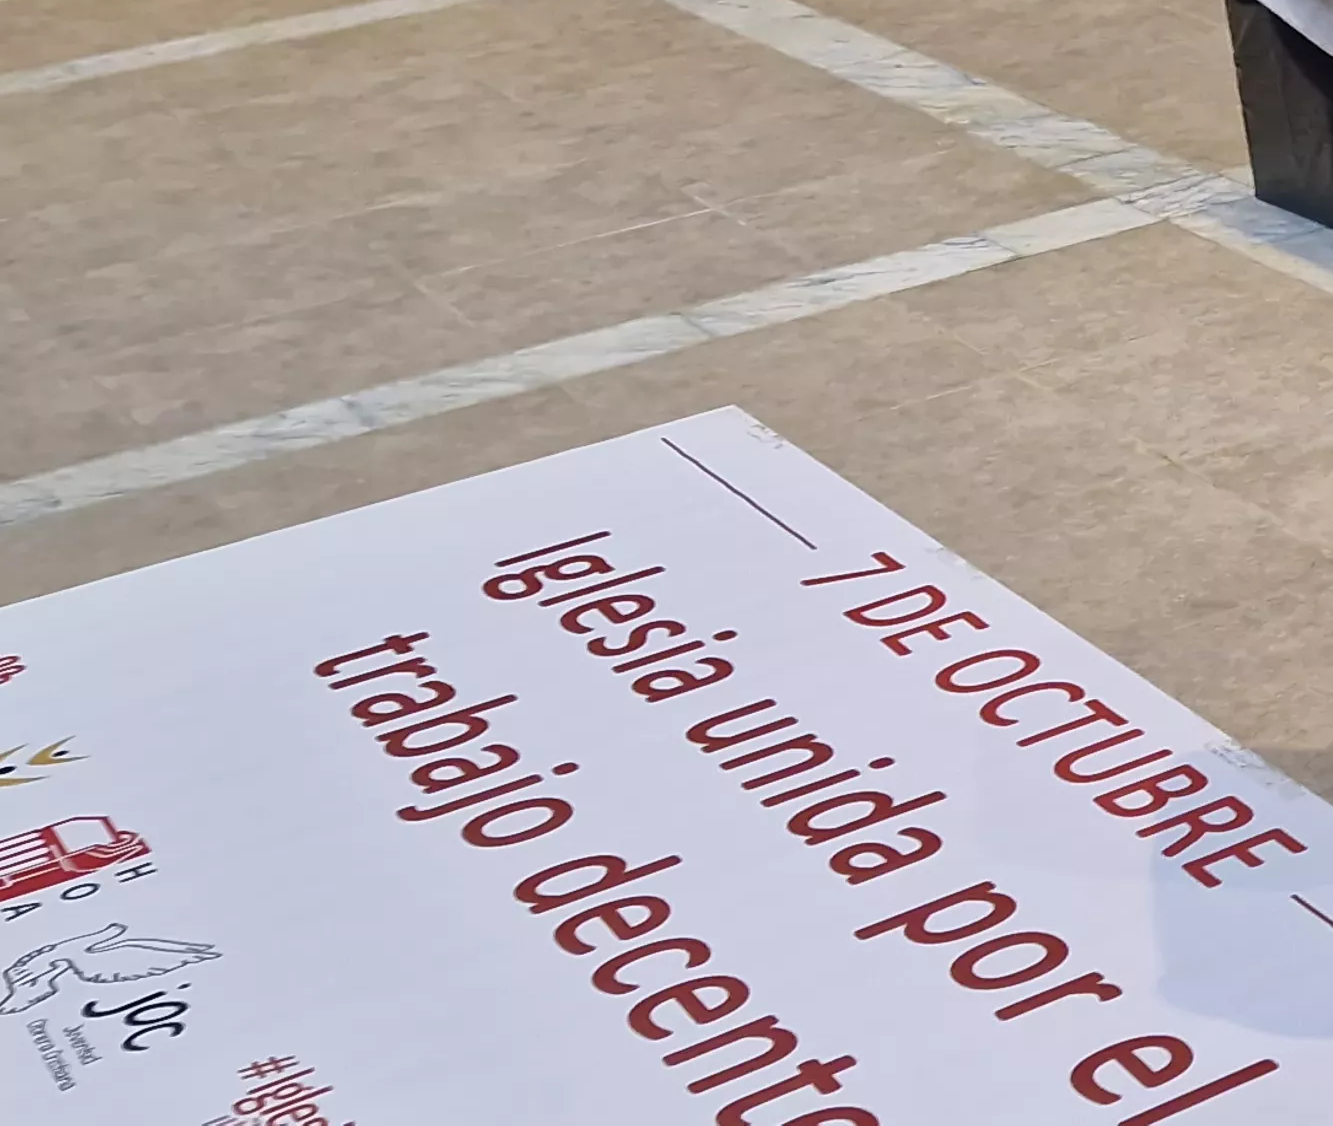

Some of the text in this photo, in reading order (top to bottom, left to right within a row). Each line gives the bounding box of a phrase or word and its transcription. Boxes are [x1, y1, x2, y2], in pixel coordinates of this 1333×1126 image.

[313, 631, 881, 1126] trabajo decent
[482, 530, 1280, 1126] Iglesia unida por el
[800, 551, 1309, 888] 7 DE OCTUBRE
[80, 982, 192, 1052] joc
